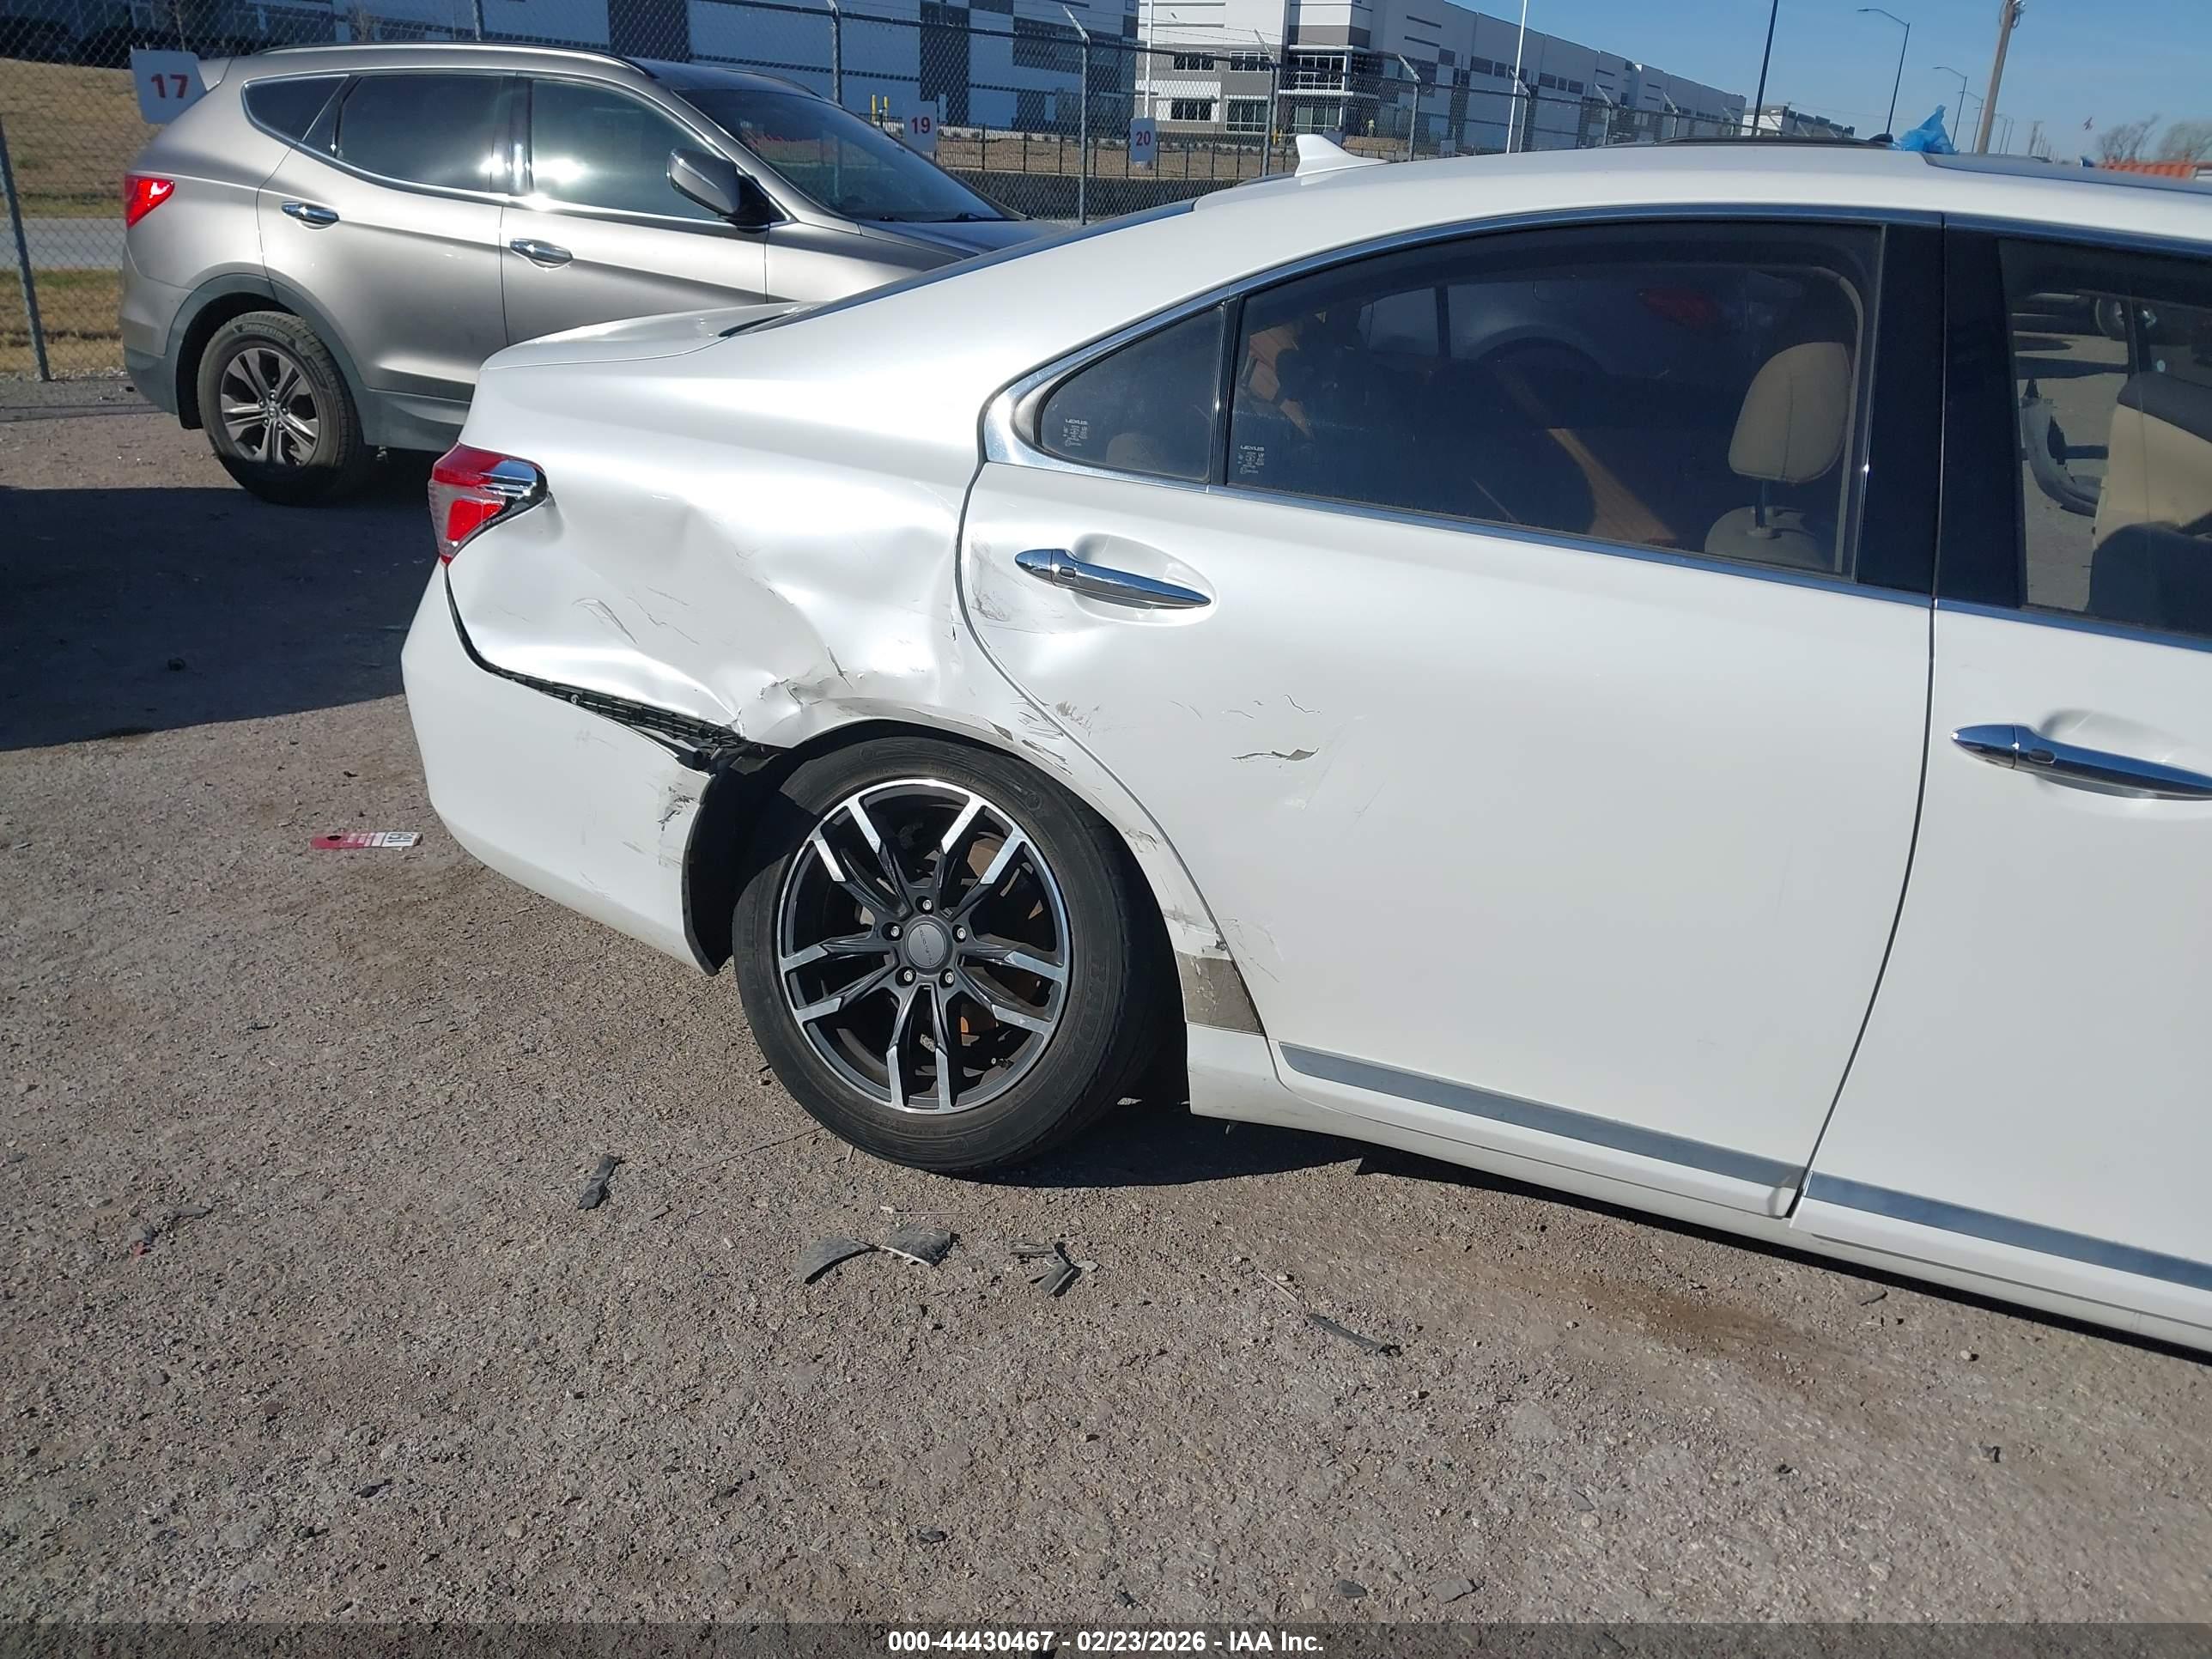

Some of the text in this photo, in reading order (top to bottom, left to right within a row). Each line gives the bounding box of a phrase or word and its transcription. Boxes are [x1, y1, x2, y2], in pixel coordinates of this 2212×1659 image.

[151, 74, 188, 98] 17
[911, 116, 931, 134] 19
[1135, 130, 1152, 146] 20
